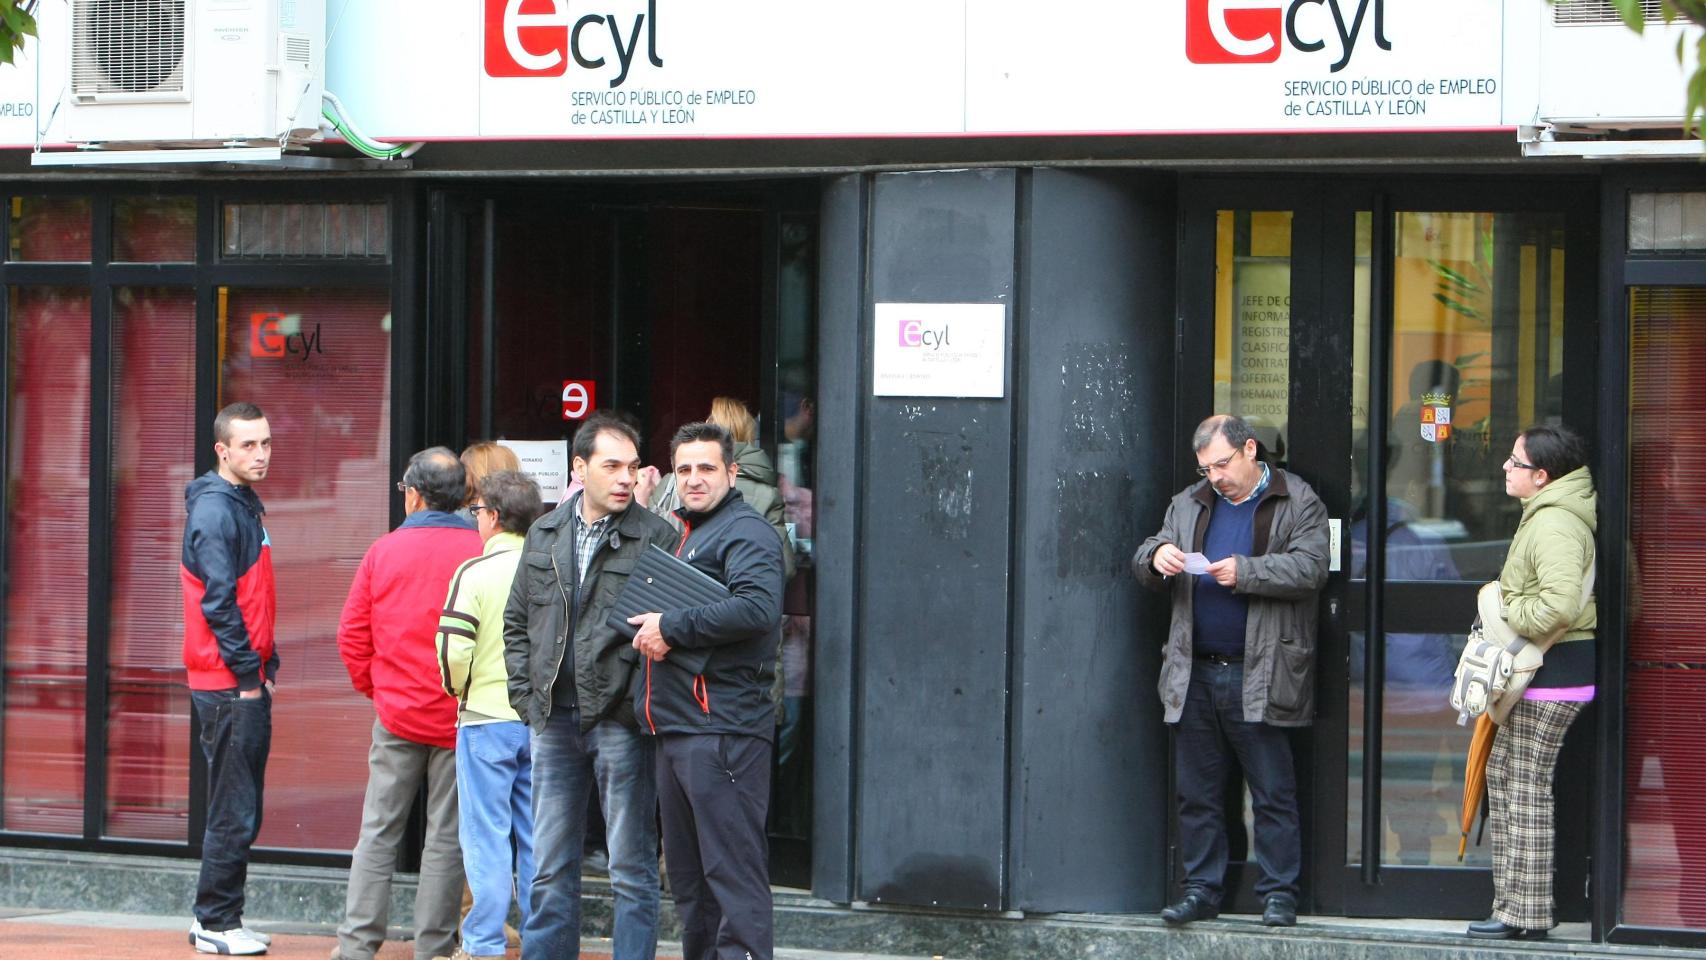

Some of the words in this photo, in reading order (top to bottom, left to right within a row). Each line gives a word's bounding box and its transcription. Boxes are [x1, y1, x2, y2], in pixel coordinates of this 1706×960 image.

[1284, 80, 1347, 96] SERVICIO
[1352, 76, 1413, 95] PÚBLICO
[1417, 80, 1435, 95] de
[1440, 79, 1496, 95] EMPLEO
[571, 91, 626, 106] SERVICIO
[630, 88, 683, 106] PÚBLICO
[687, 91, 702, 105] de
[706, 90, 756, 105] EMPLEO
[0, 103, 33, 116] MPLEO
[1284, 101, 1301, 116] de
[1306, 100, 1371, 115] CASTILLA
[1375, 100, 1384, 115] Y
[1389, 96, 1426, 115] LEÓN
[571, 110, 586, 125] de
[590, 110, 647, 124] CASTILLA
[650, 110, 658, 124] Y
[662, 105, 695, 124] LEÓN
[1241, 295, 1263, 306] JEFE
[1267, 295, 1280, 306] DE
[1242, 311, 1289, 322] INFORMA
[904, 321, 950, 351] ecyl
[1241, 342, 1288, 353] CLASIFIC
[1241, 357, 1289, 369] CONTRAT
[1240, 373, 1286, 384] OFERTAS
[1241, 388, 1288, 400] DEMAND
[1240, 404, 1282, 415] CURSOS
